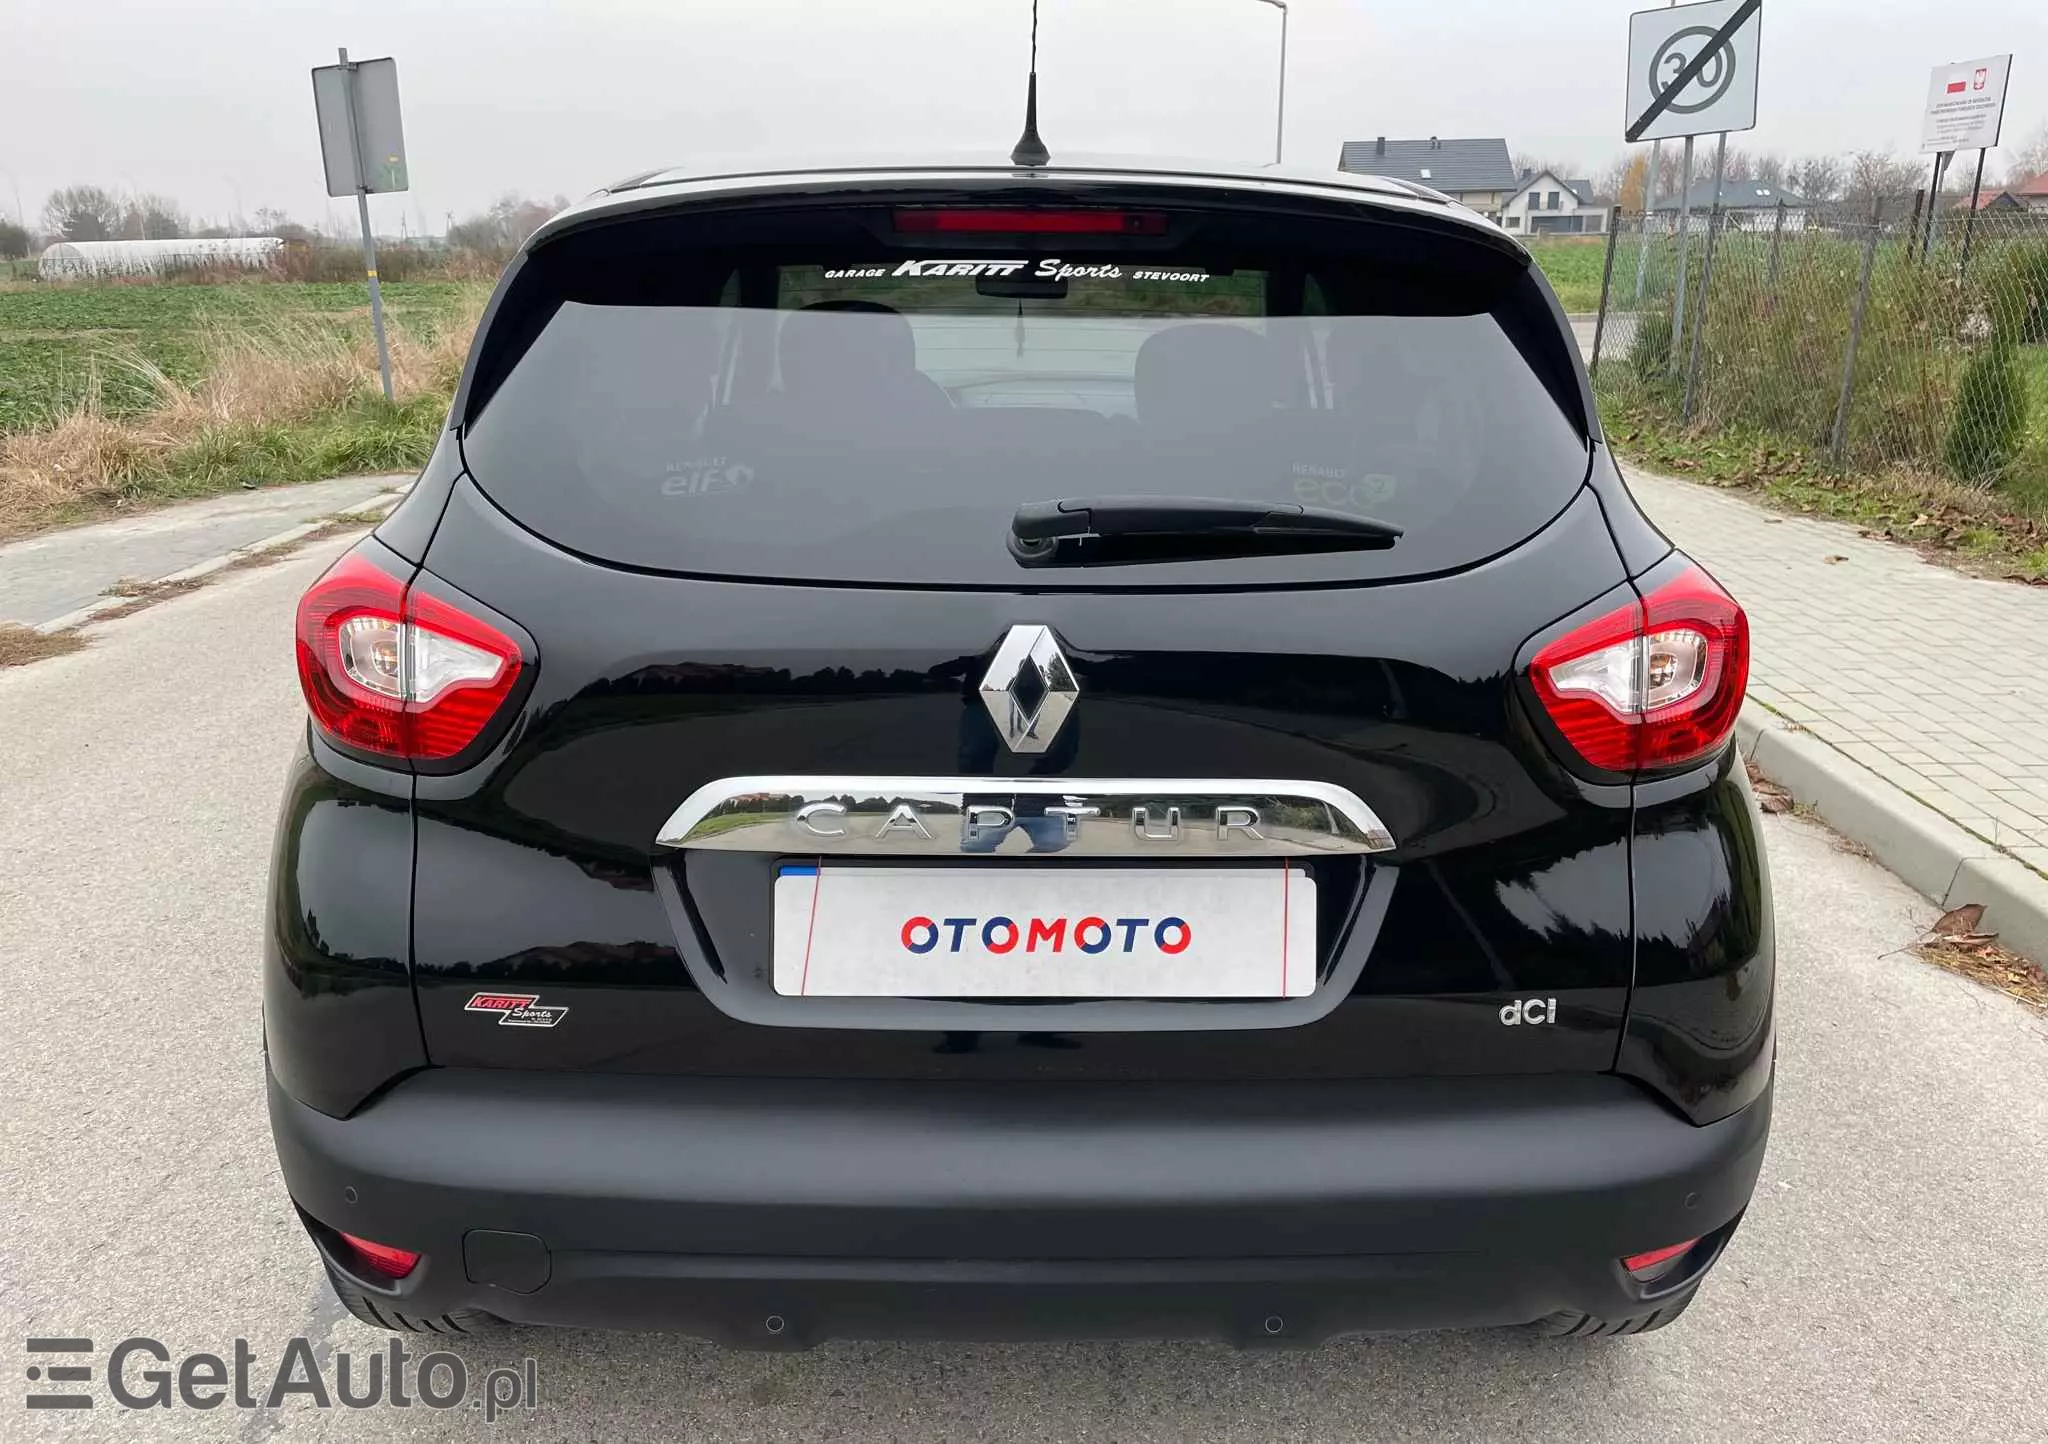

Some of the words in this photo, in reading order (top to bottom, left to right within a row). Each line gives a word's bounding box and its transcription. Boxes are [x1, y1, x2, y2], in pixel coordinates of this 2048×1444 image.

[1660, 50, 1723, 92] 30
[824, 268, 885, 279] GARAGE
[892, 259, 1029, 277] KARITT
[1034, 259, 1122, 282] Sports
[1133, 270, 1210, 283] STEVOORT
[796, 803, 1264, 842] CAPTUR
[471, 996, 533, 1008] KARITT
[512, 1007, 552, 1019] Sports
